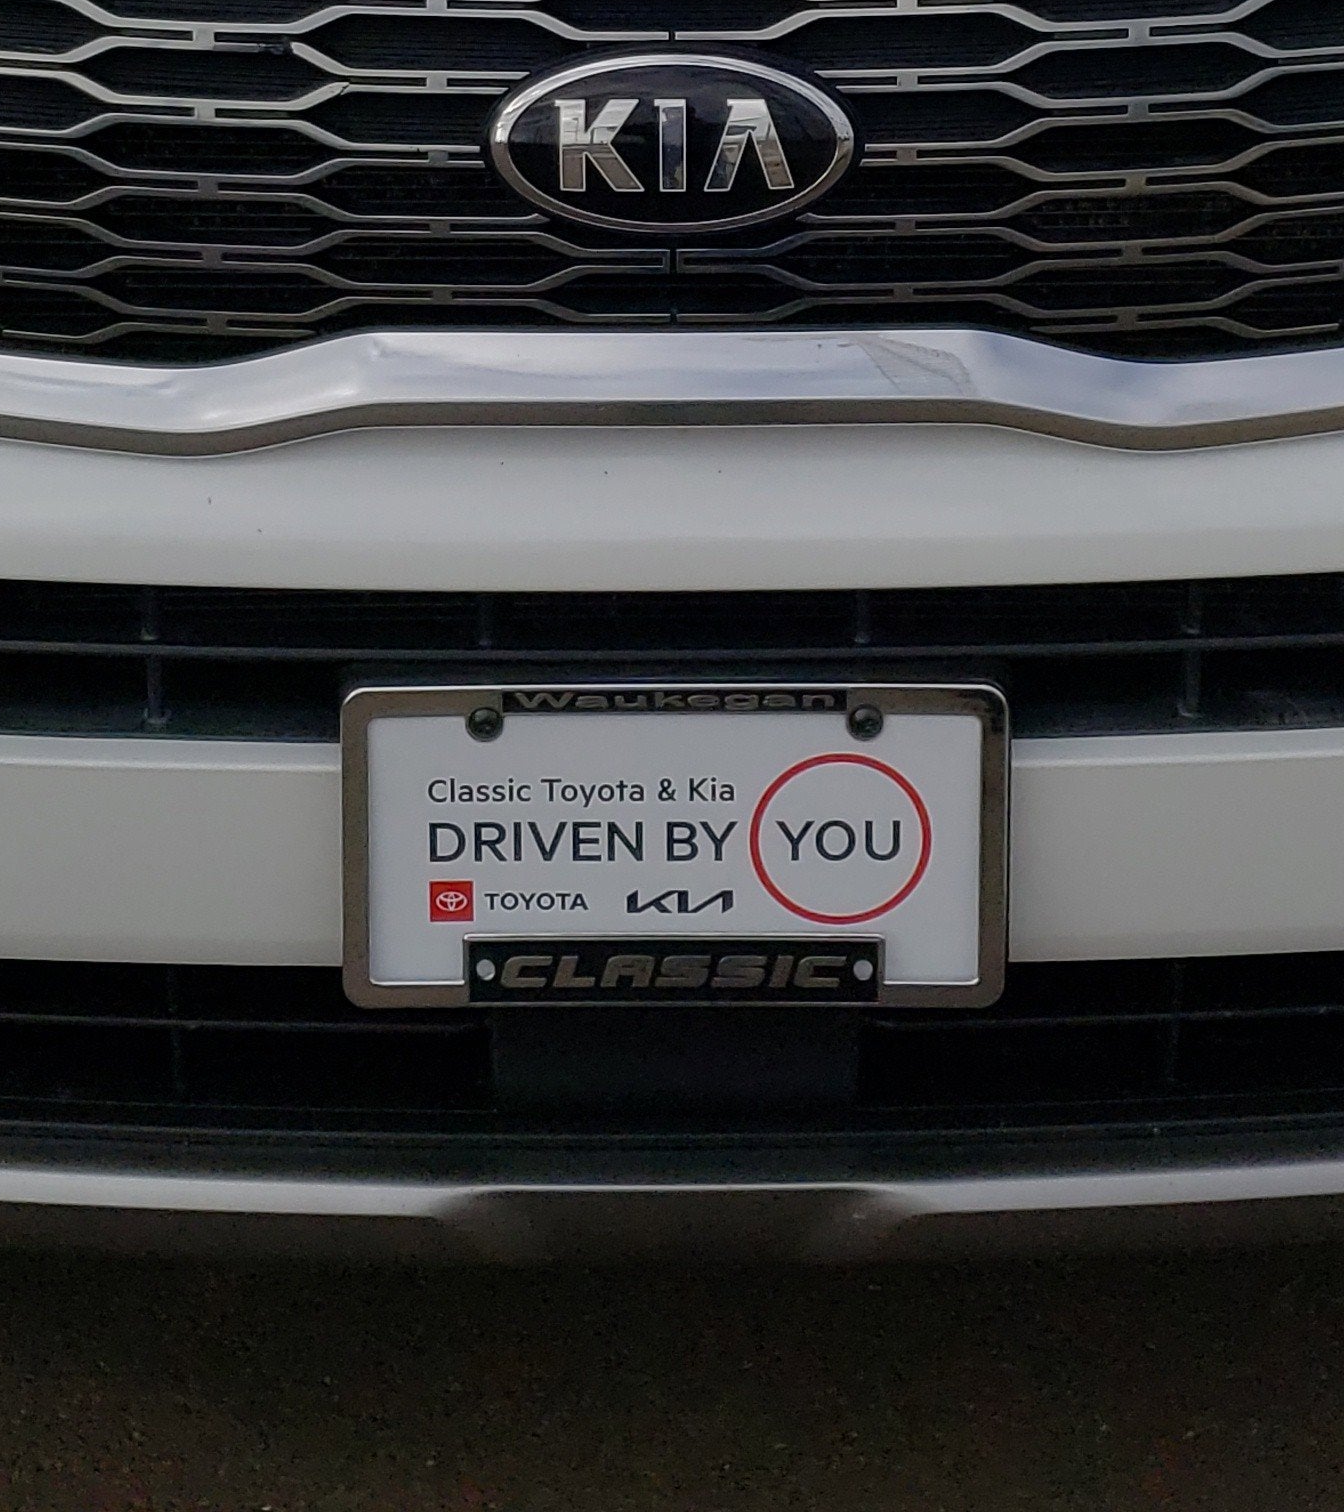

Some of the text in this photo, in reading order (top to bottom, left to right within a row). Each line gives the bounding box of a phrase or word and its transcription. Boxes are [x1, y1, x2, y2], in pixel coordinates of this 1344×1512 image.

[554, 98, 795, 192] KIA
[515, 691, 835, 710] Waukegan
[427, 776, 736, 807] Classic Toyota & Kia
[428, 820, 900, 862] DRIVEN BY YOU
[484, 893, 589, 911] TOYOTA
[501, 954, 848, 989] CLASSIC
